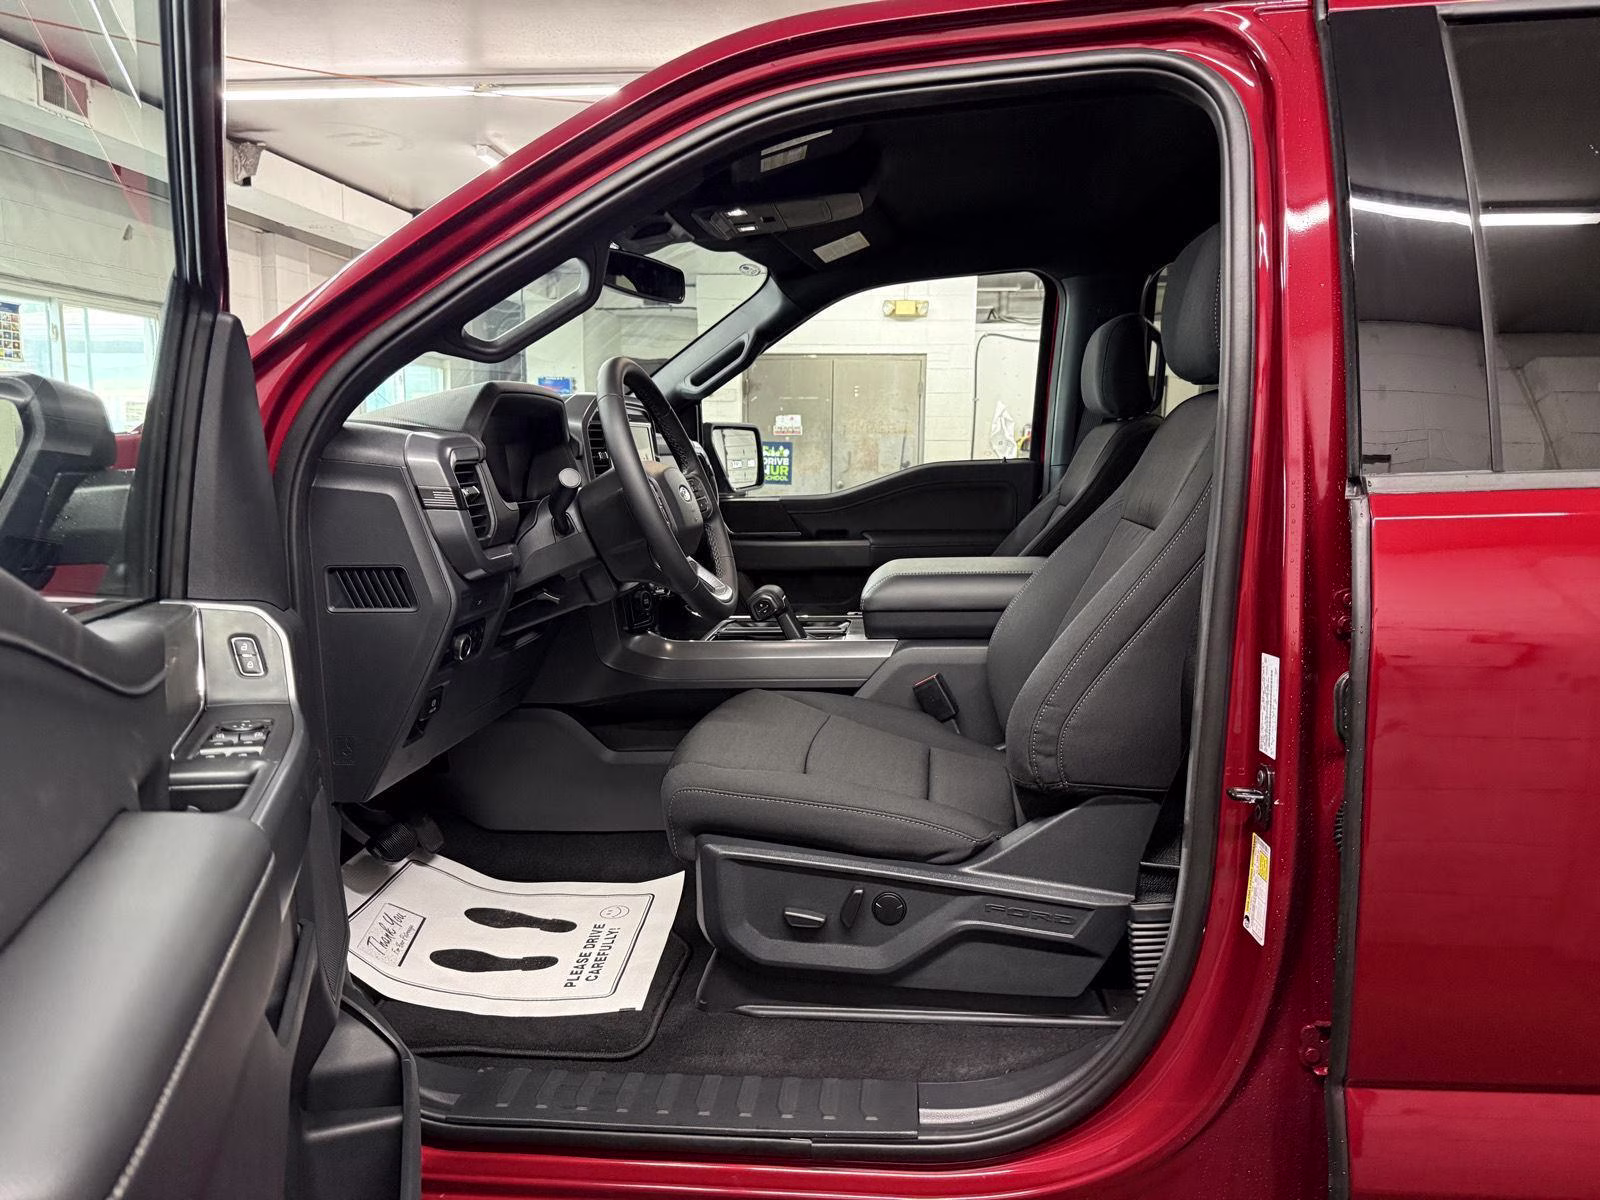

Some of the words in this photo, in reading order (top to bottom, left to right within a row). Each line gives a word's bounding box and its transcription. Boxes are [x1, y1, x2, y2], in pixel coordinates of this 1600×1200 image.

[366, 922, 397, 956] Thank
[382, 912, 407, 928] You
[985, 903, 1076, 925] FORD
[563, 951, 592, 988] PLEASE
[583, 923, 606, 950] DRIVE
[585, 927, 621, 982] CAREFULLY!
